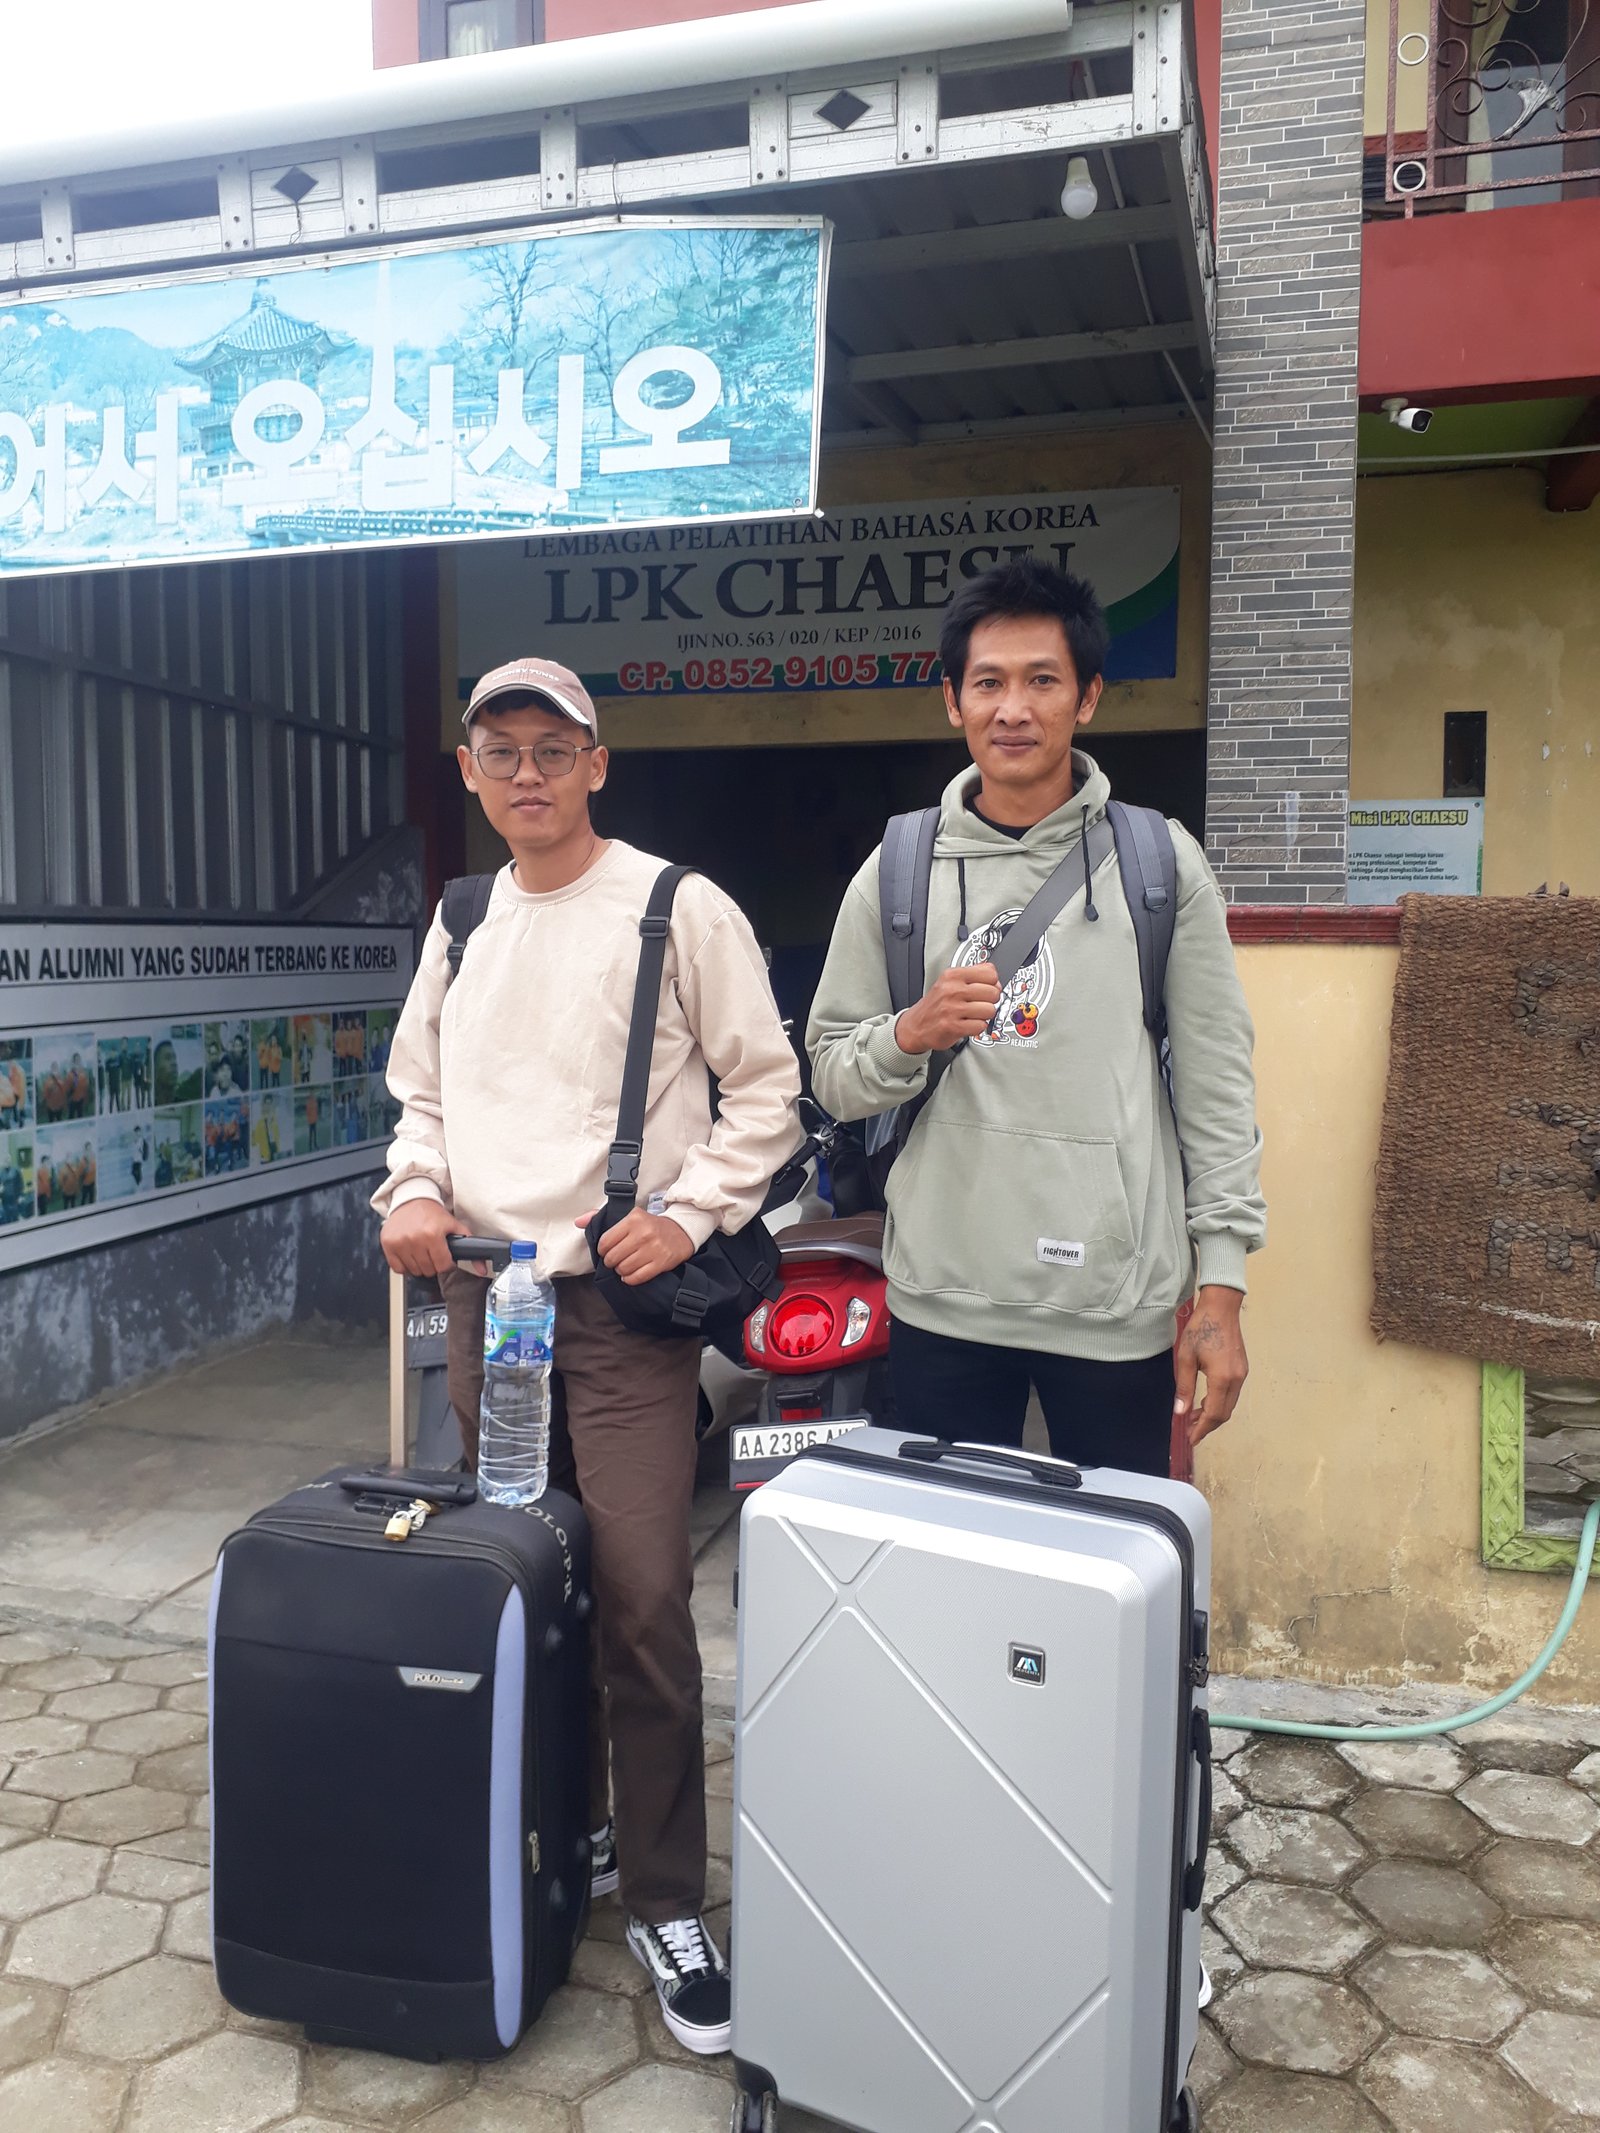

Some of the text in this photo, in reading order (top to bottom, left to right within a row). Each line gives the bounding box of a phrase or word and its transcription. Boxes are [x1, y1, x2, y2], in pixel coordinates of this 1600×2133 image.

[0, 343, 730, 535] 어서 오십시오
[523, 503, 1100, 558] LEMBAGA PELATIHAN BAHASA KOREA
[543, 562, 704, 625] LPK
[677, 633, 707, 653] IJIN
[711, 632, 743, 648] NO.
[746, 629, 775, 648] 563
[789, 628, 819, 646] 020
[834, 626, 870, 644] KEP
[618, 649, 945, 691] CP. 0852 9105 77
[1350, 809, 1469, 826] Misi LPK CHAESU
[39, 946, 125, 980] ALUMNI
[131, 946, 186, 977] YANG
[191, 946, 250, 975] SUDAH
[255, 944, 327, 973] TERBANG
[331, 944, 350, 971] KE
[354, 943, 398, 970] KOREA
[1010, 1038, 1040, 1049] REALISTIC
[1043, 1246, 1080, 1259] FIGHTOVER
[738, 1434, 765, 1458] AA
[769, 1430, 817, 1456] 2386
